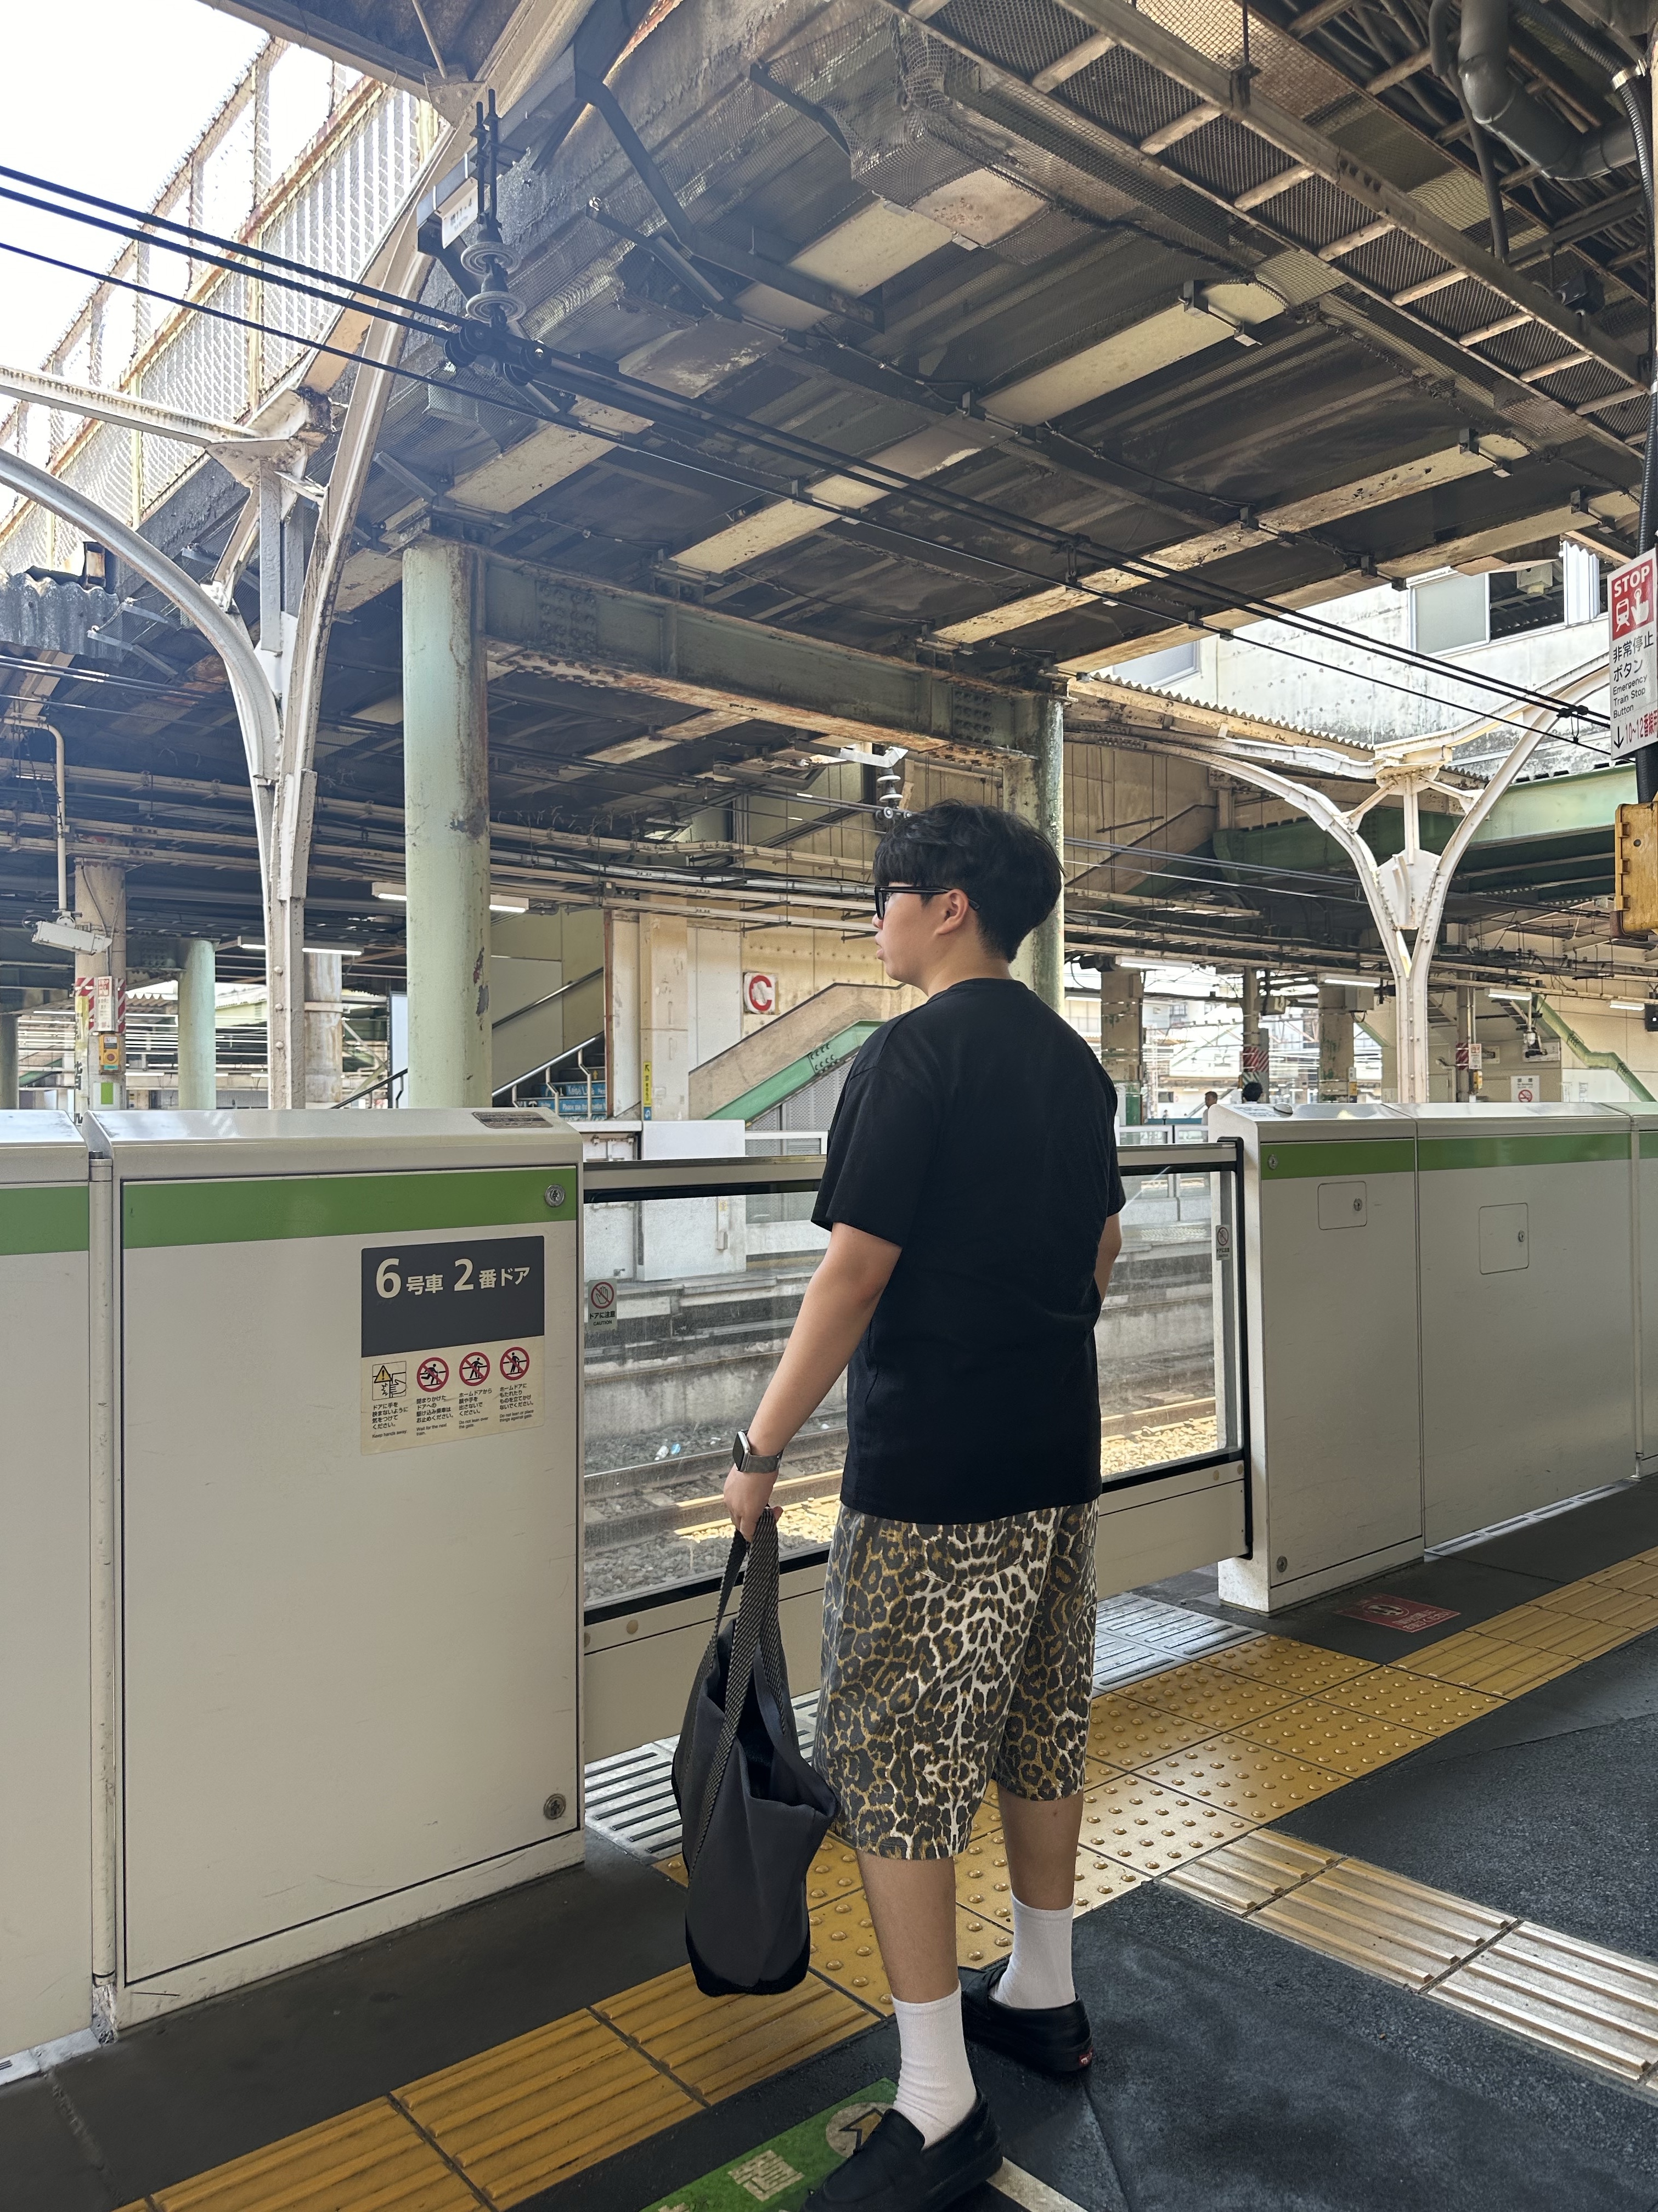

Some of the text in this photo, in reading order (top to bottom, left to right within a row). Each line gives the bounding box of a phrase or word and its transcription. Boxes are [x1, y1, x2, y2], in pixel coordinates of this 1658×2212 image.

[1614, 566, 1650, 597] STOP
[1613, 631, 1654, 663] 非常停止
[1614, 659, 1643, 682] ボタン
[1613, 674, 1648, 696] Emergency
[1614, 687, 1646, 707] Train Stop
[1613, 704, 1634, 719] Button
[375, 1258, 531, 1299] 6号車 2番ドア
[590, 1311, 616, 1319] ドアに注意
[459, 1388, 492, 1397] ホームドアから
[500, 1383, 527, 1392] ホームドアに
[373, 1402, 398, 1410] ドアに手を
